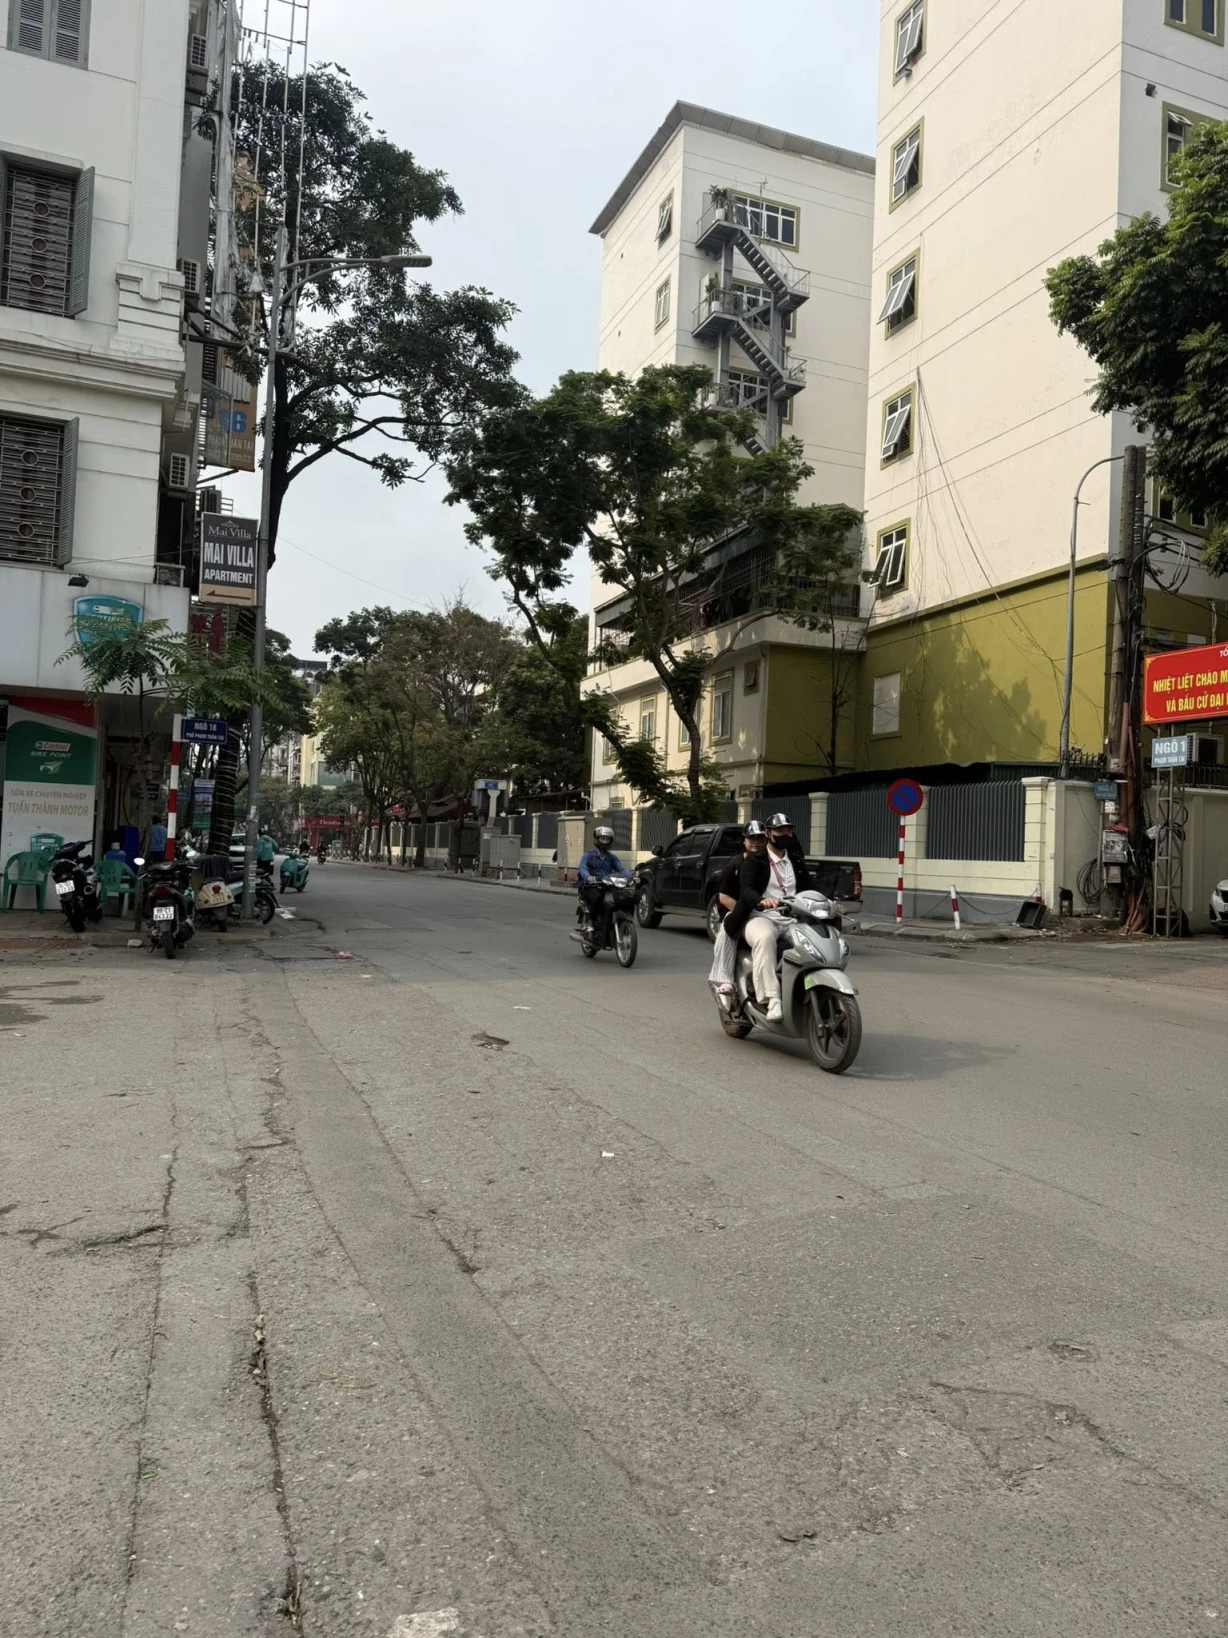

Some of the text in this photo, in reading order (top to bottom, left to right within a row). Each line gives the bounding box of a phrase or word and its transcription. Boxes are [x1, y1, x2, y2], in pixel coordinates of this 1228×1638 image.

[208, 525, 251, 539] Mai Villa
[227, 544, 254, 568] VILLA
[204, 568, 253, 584] APARTMENT
[1153, 675, 1176, 694] NHIỆT
[1177, 672, 1194, 692] LIỆT
[1196, 669, 1218, 687] CHÀO
[1166, 696, 1177, 713] VÀ
[1209, 693, 1224, 710] ĐẠI
[209, 723, 217, 732] 18
[43, 742, 68, 751] Castrol
[1180, 740, 1186, 753] 1
[63, 791, 88, 800] NGHIỆP
[8, 799, 89, 816] TUẤN THÀNH MOTOR
